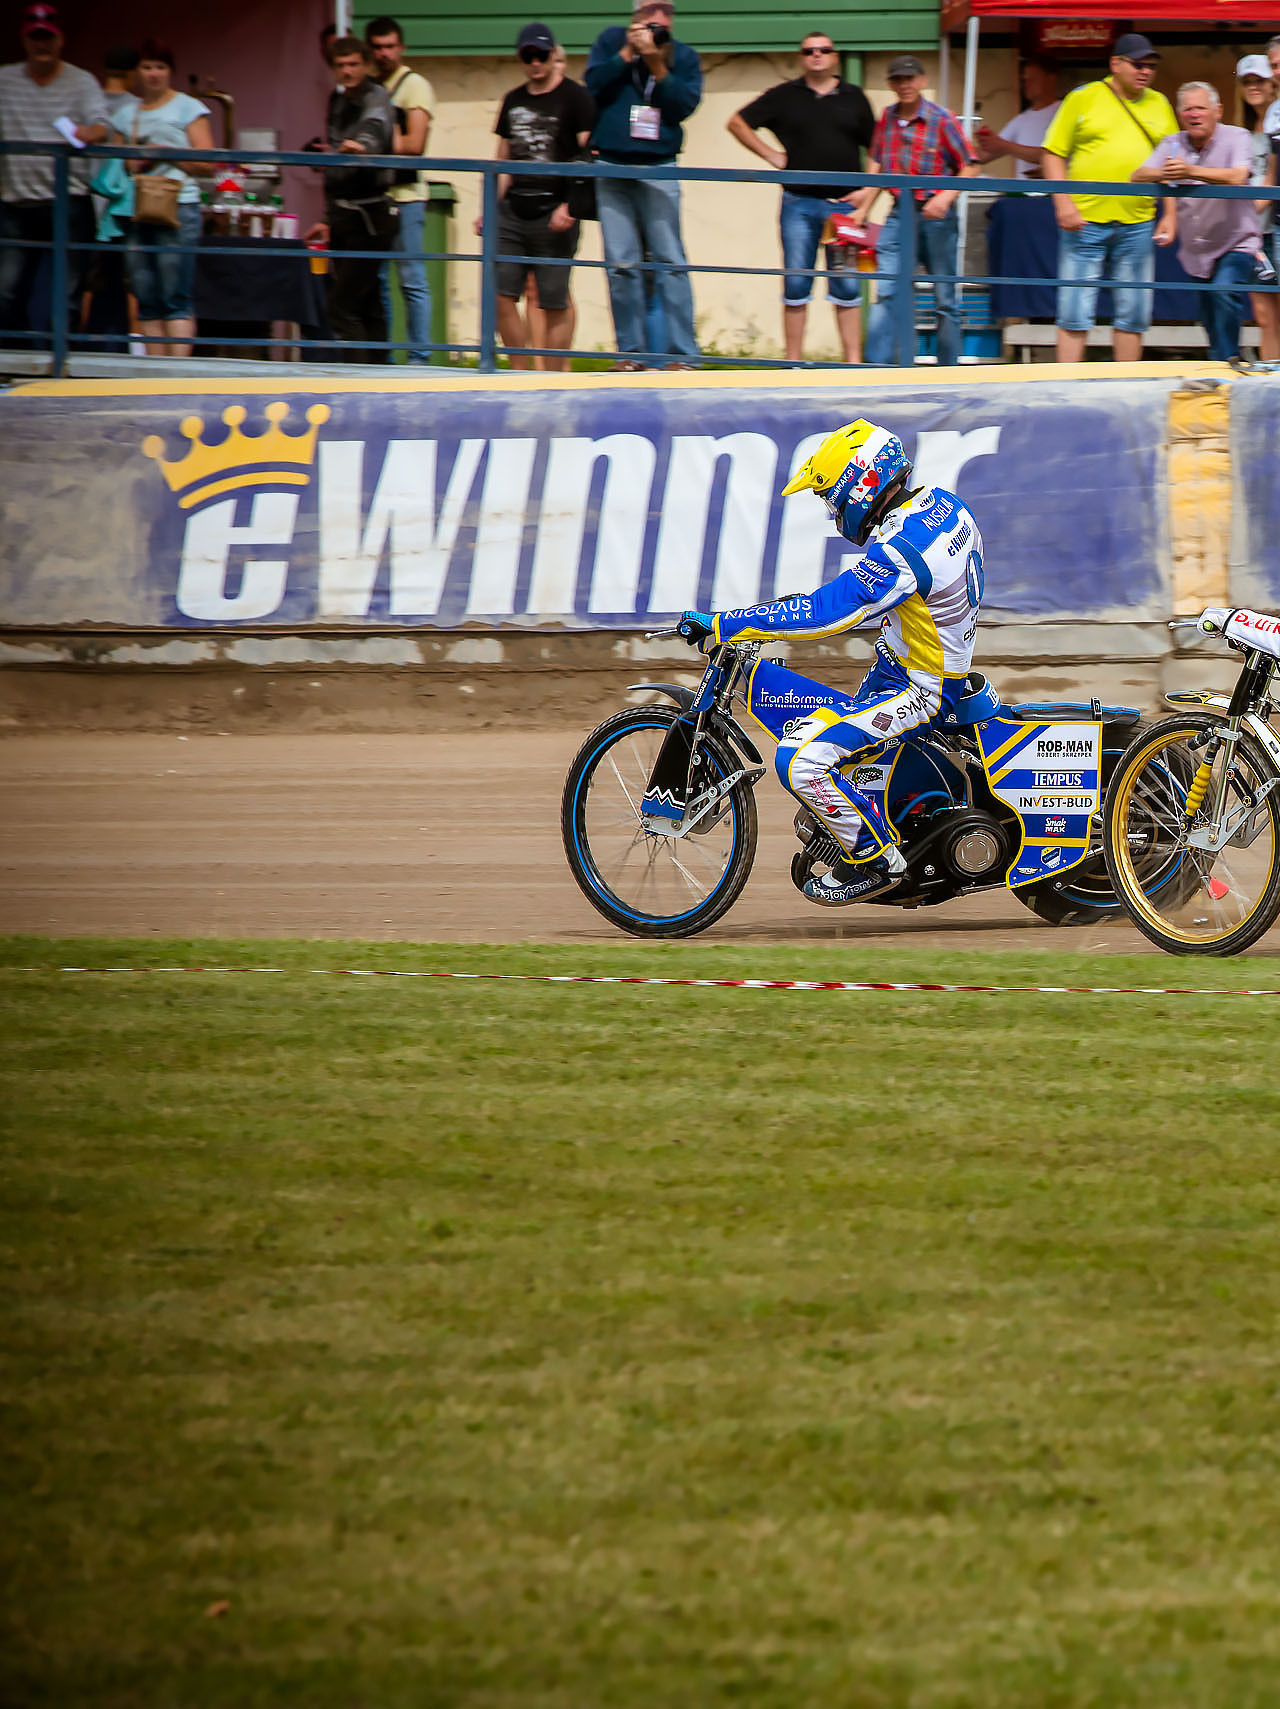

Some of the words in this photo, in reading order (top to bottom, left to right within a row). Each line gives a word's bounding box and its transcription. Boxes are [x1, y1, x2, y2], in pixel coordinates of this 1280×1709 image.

[724, 599, 812, 619] NICOLAUS
[768, 611, 812, 623] BANK
[760, 687, 834, 704] transformers
[1032, 771, 1083, 786] TEMPUS
[1019, 795, 1093, 808] INVEST-BUD
